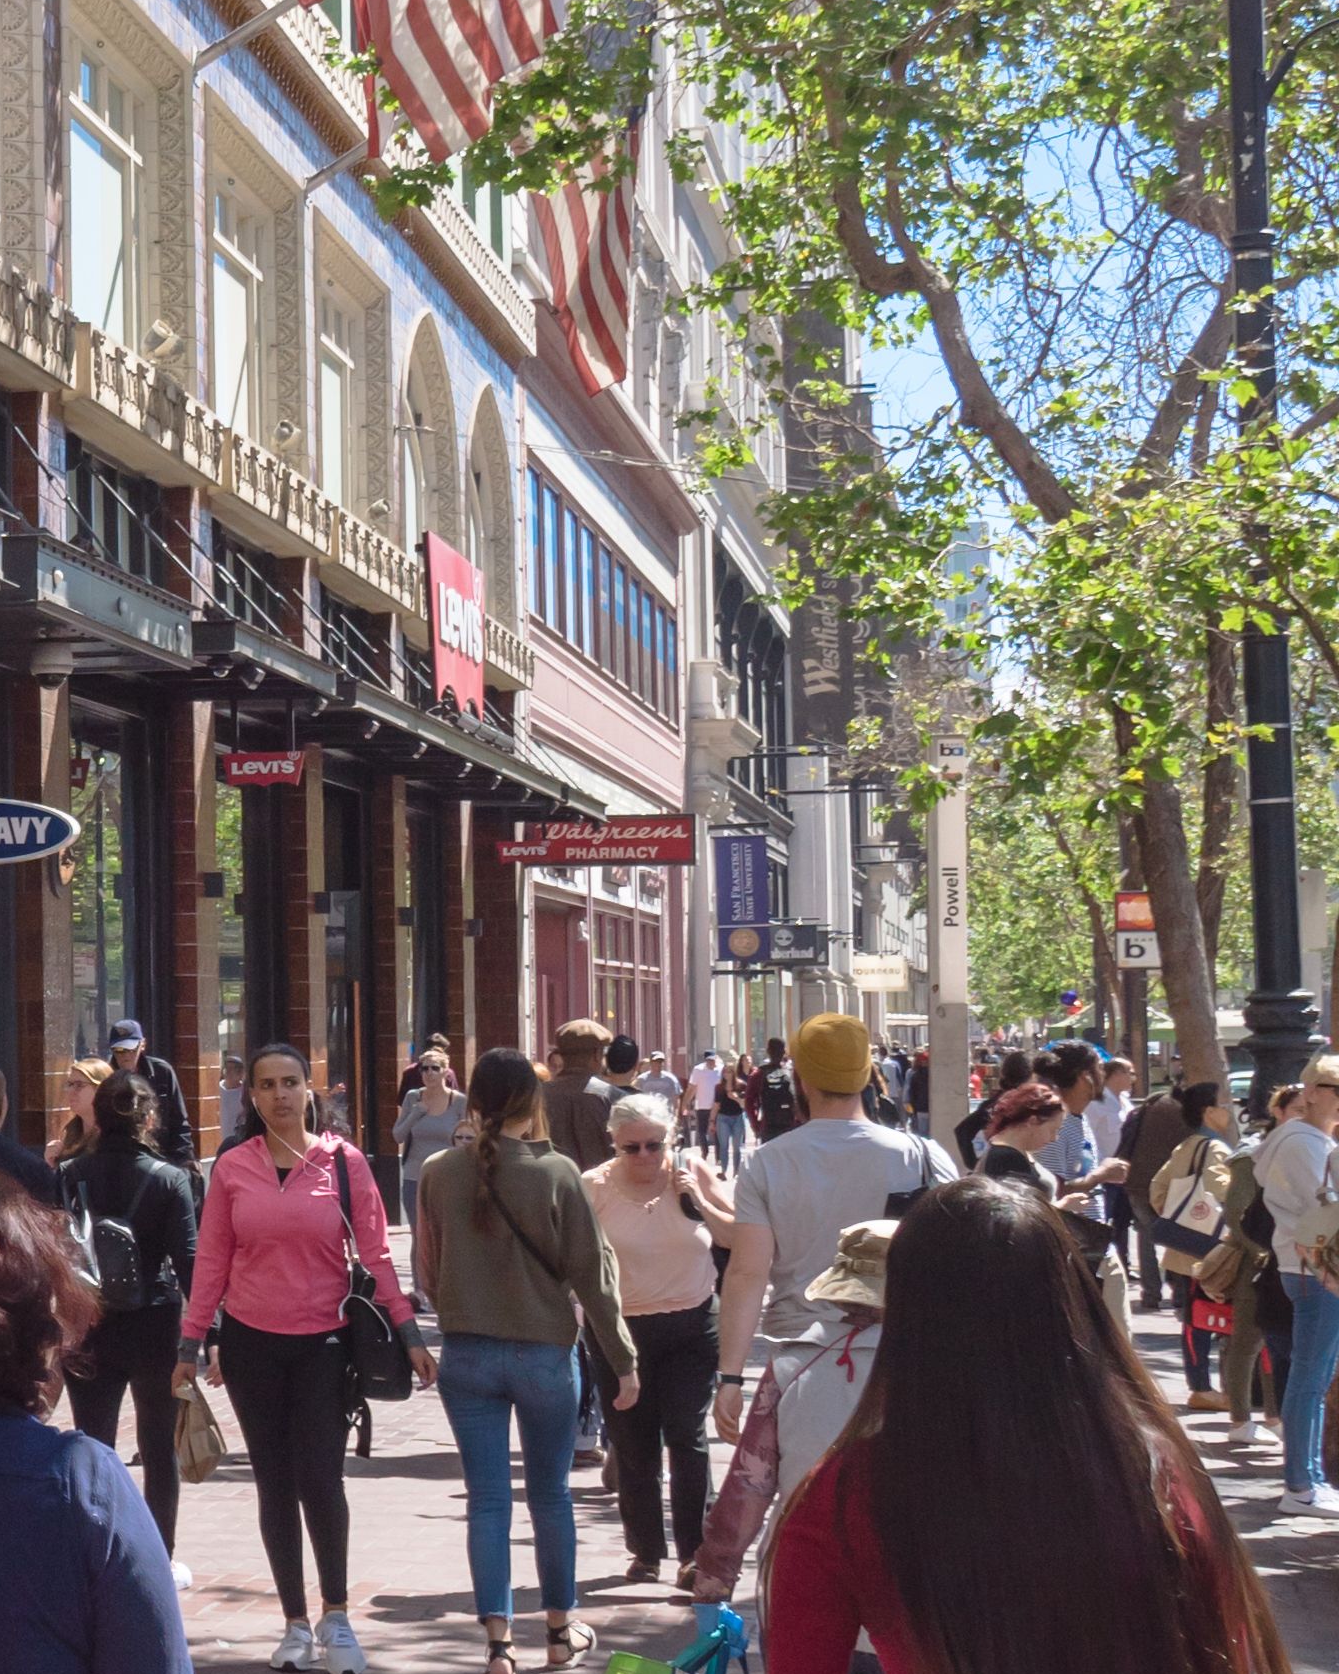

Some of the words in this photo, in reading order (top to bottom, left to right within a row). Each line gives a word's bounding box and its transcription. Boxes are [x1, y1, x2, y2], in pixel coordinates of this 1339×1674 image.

[565, 846, 659, 859] PHARMACY
[731, 842, 739, 899] FRANCISCO
[744, 843, 754, 894] UNIVERSITY
[731, 902, 741, 922] SAN
[744, 896, 754, 921] STATE
[942, 867, 959, 927] Powell
